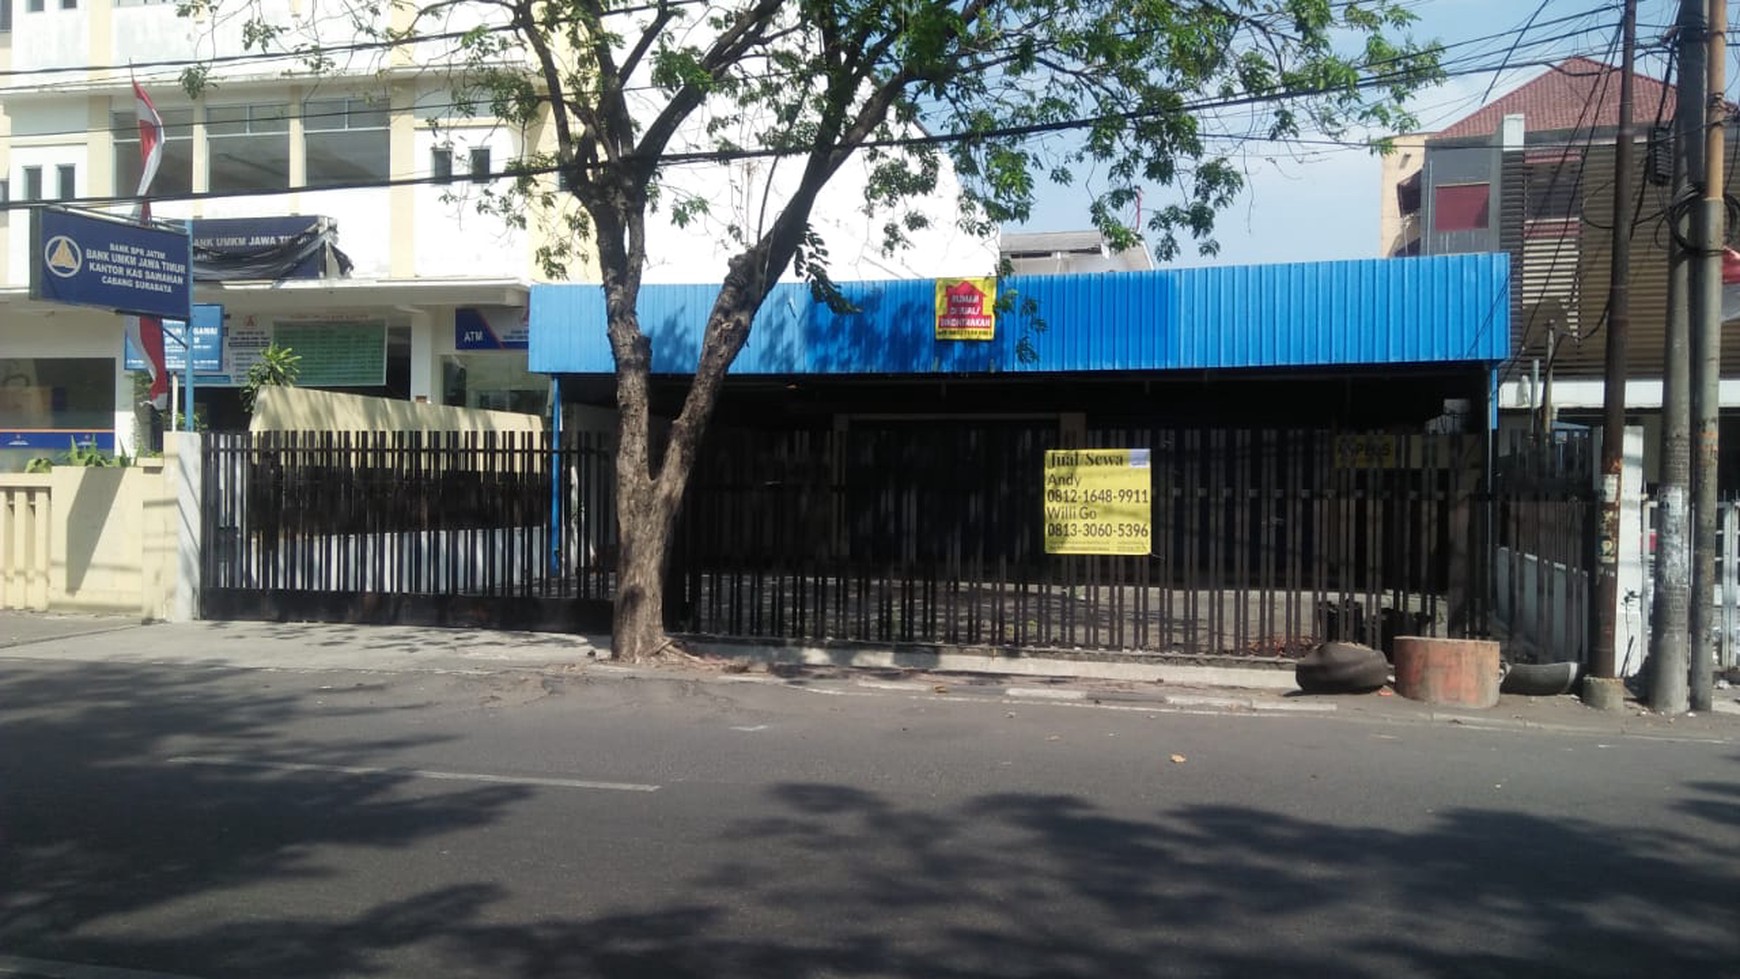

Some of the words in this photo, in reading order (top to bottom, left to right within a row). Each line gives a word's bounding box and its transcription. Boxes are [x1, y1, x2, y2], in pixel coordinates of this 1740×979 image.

[193, 238, 214, 247] ANK
[216, 237, 247, 247] UMKM
[249, 236, 277, 246] JAWA
[109, 242, 130, 253] BANK
[130, 246, 145, 256] BPR
[145, 249, 166, 260] JATIM
[86, 248, 110, 261] BANK
[111, 253, 137, 266] UMKM
[138, 258, 160, 270] JAWA
[162, 261, 186, 275] TIMUR
[89, 262, 125, 276] KANTOR
[125, 268, 143, 279] KAS
[101, 275, 134, 288] CABANG
[134, 280, 173, 294] SURABAYA
[463, 330, 483, 342] ATM
[1050, 451, 1079, 468] Jual
[1085, 452, 1124, 467] Sewa
[1047, 473, 1081, 487] Andy
[1047, 489, 1149, 503] 0812-1648-9911
[1047, 506, 1077, 520] Willi
[1079, 506, 1097, 520] Go
[1047, 523, 1149, 537] 0813-3060-5396
